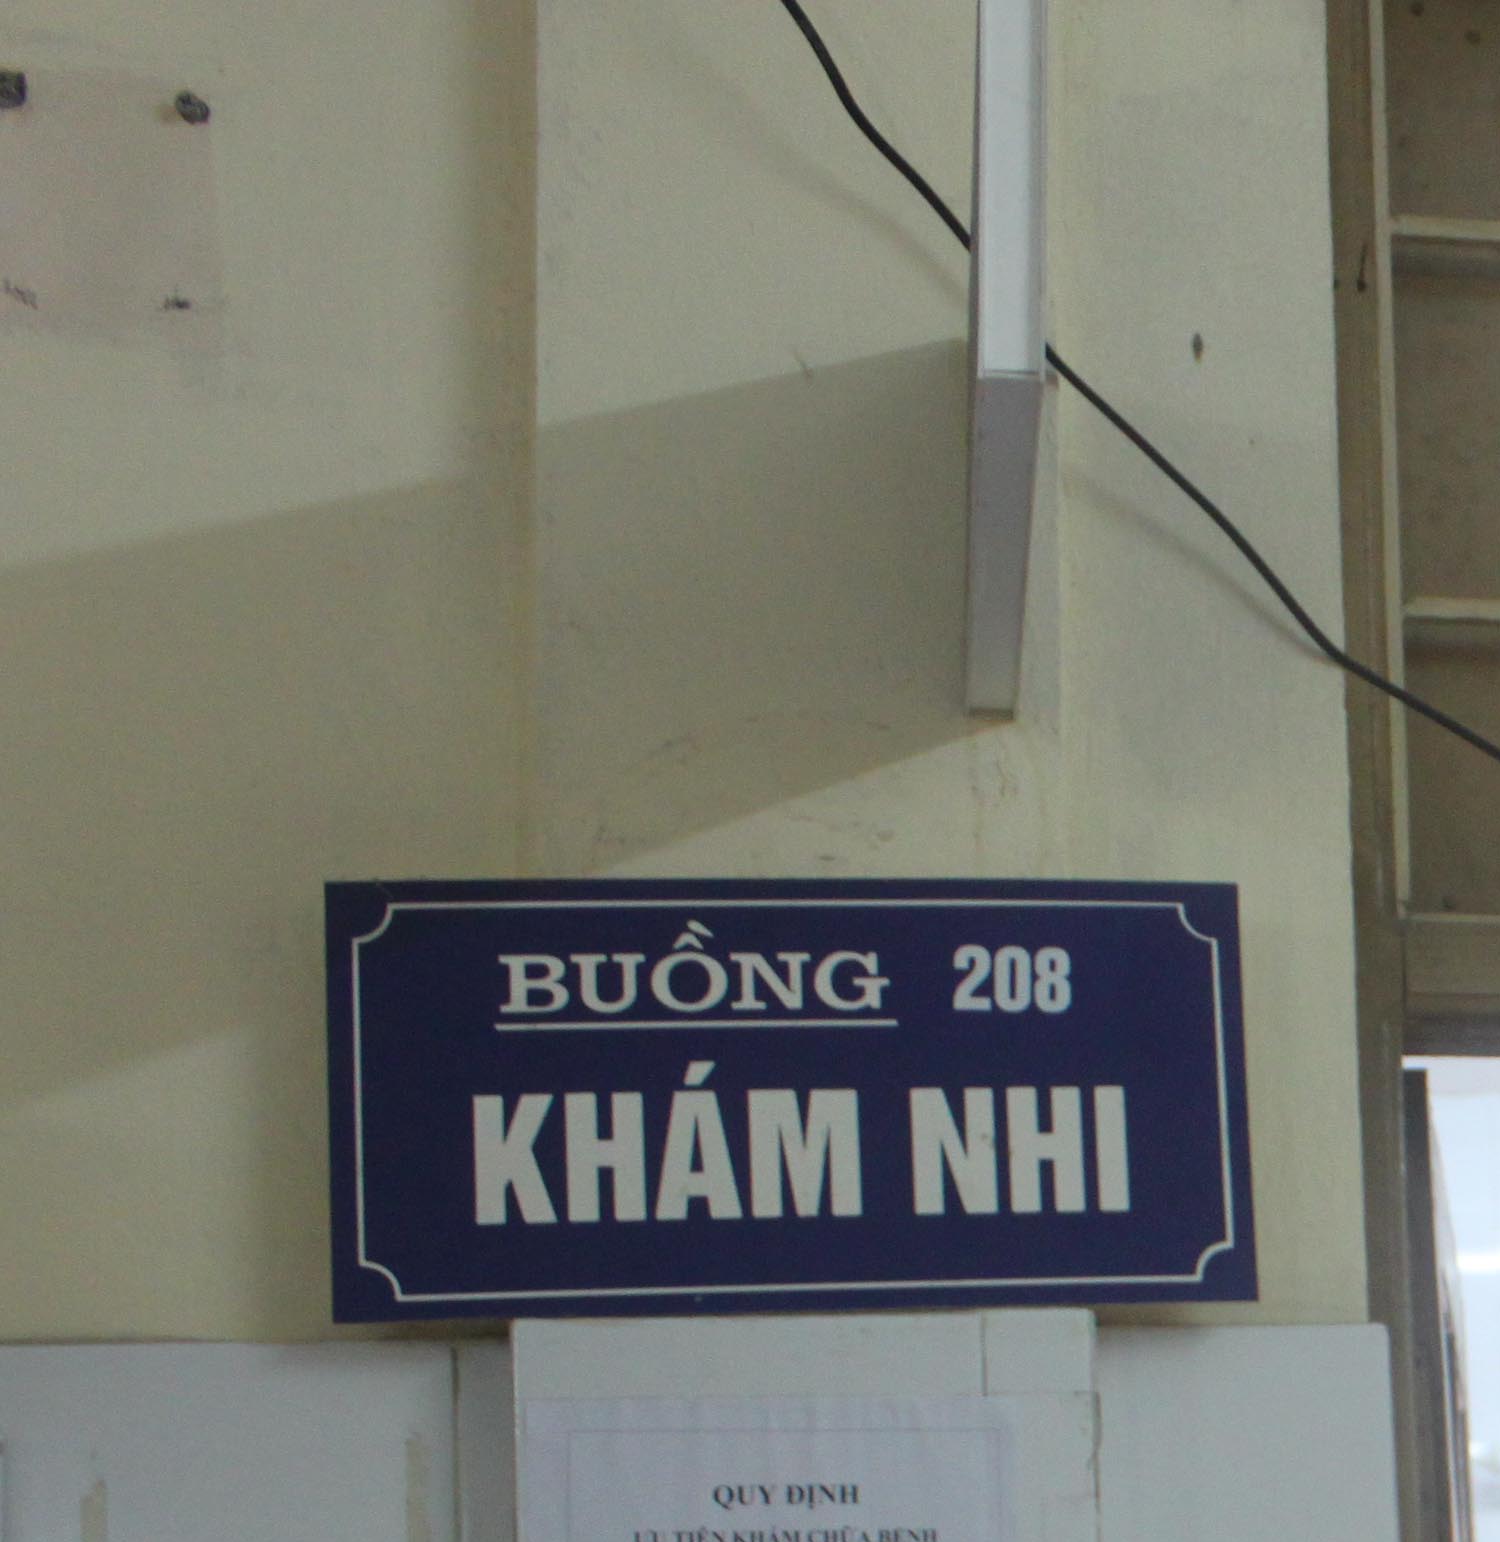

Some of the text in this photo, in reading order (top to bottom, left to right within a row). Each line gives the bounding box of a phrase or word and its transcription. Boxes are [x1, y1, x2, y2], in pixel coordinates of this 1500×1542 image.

[497, 919, 1073, 1014] BUỒNG 208
[471, 1060, 1131, 1226] KHÁM NHI
[712, 1483, 860, 1511] QUY ĐỊNH
